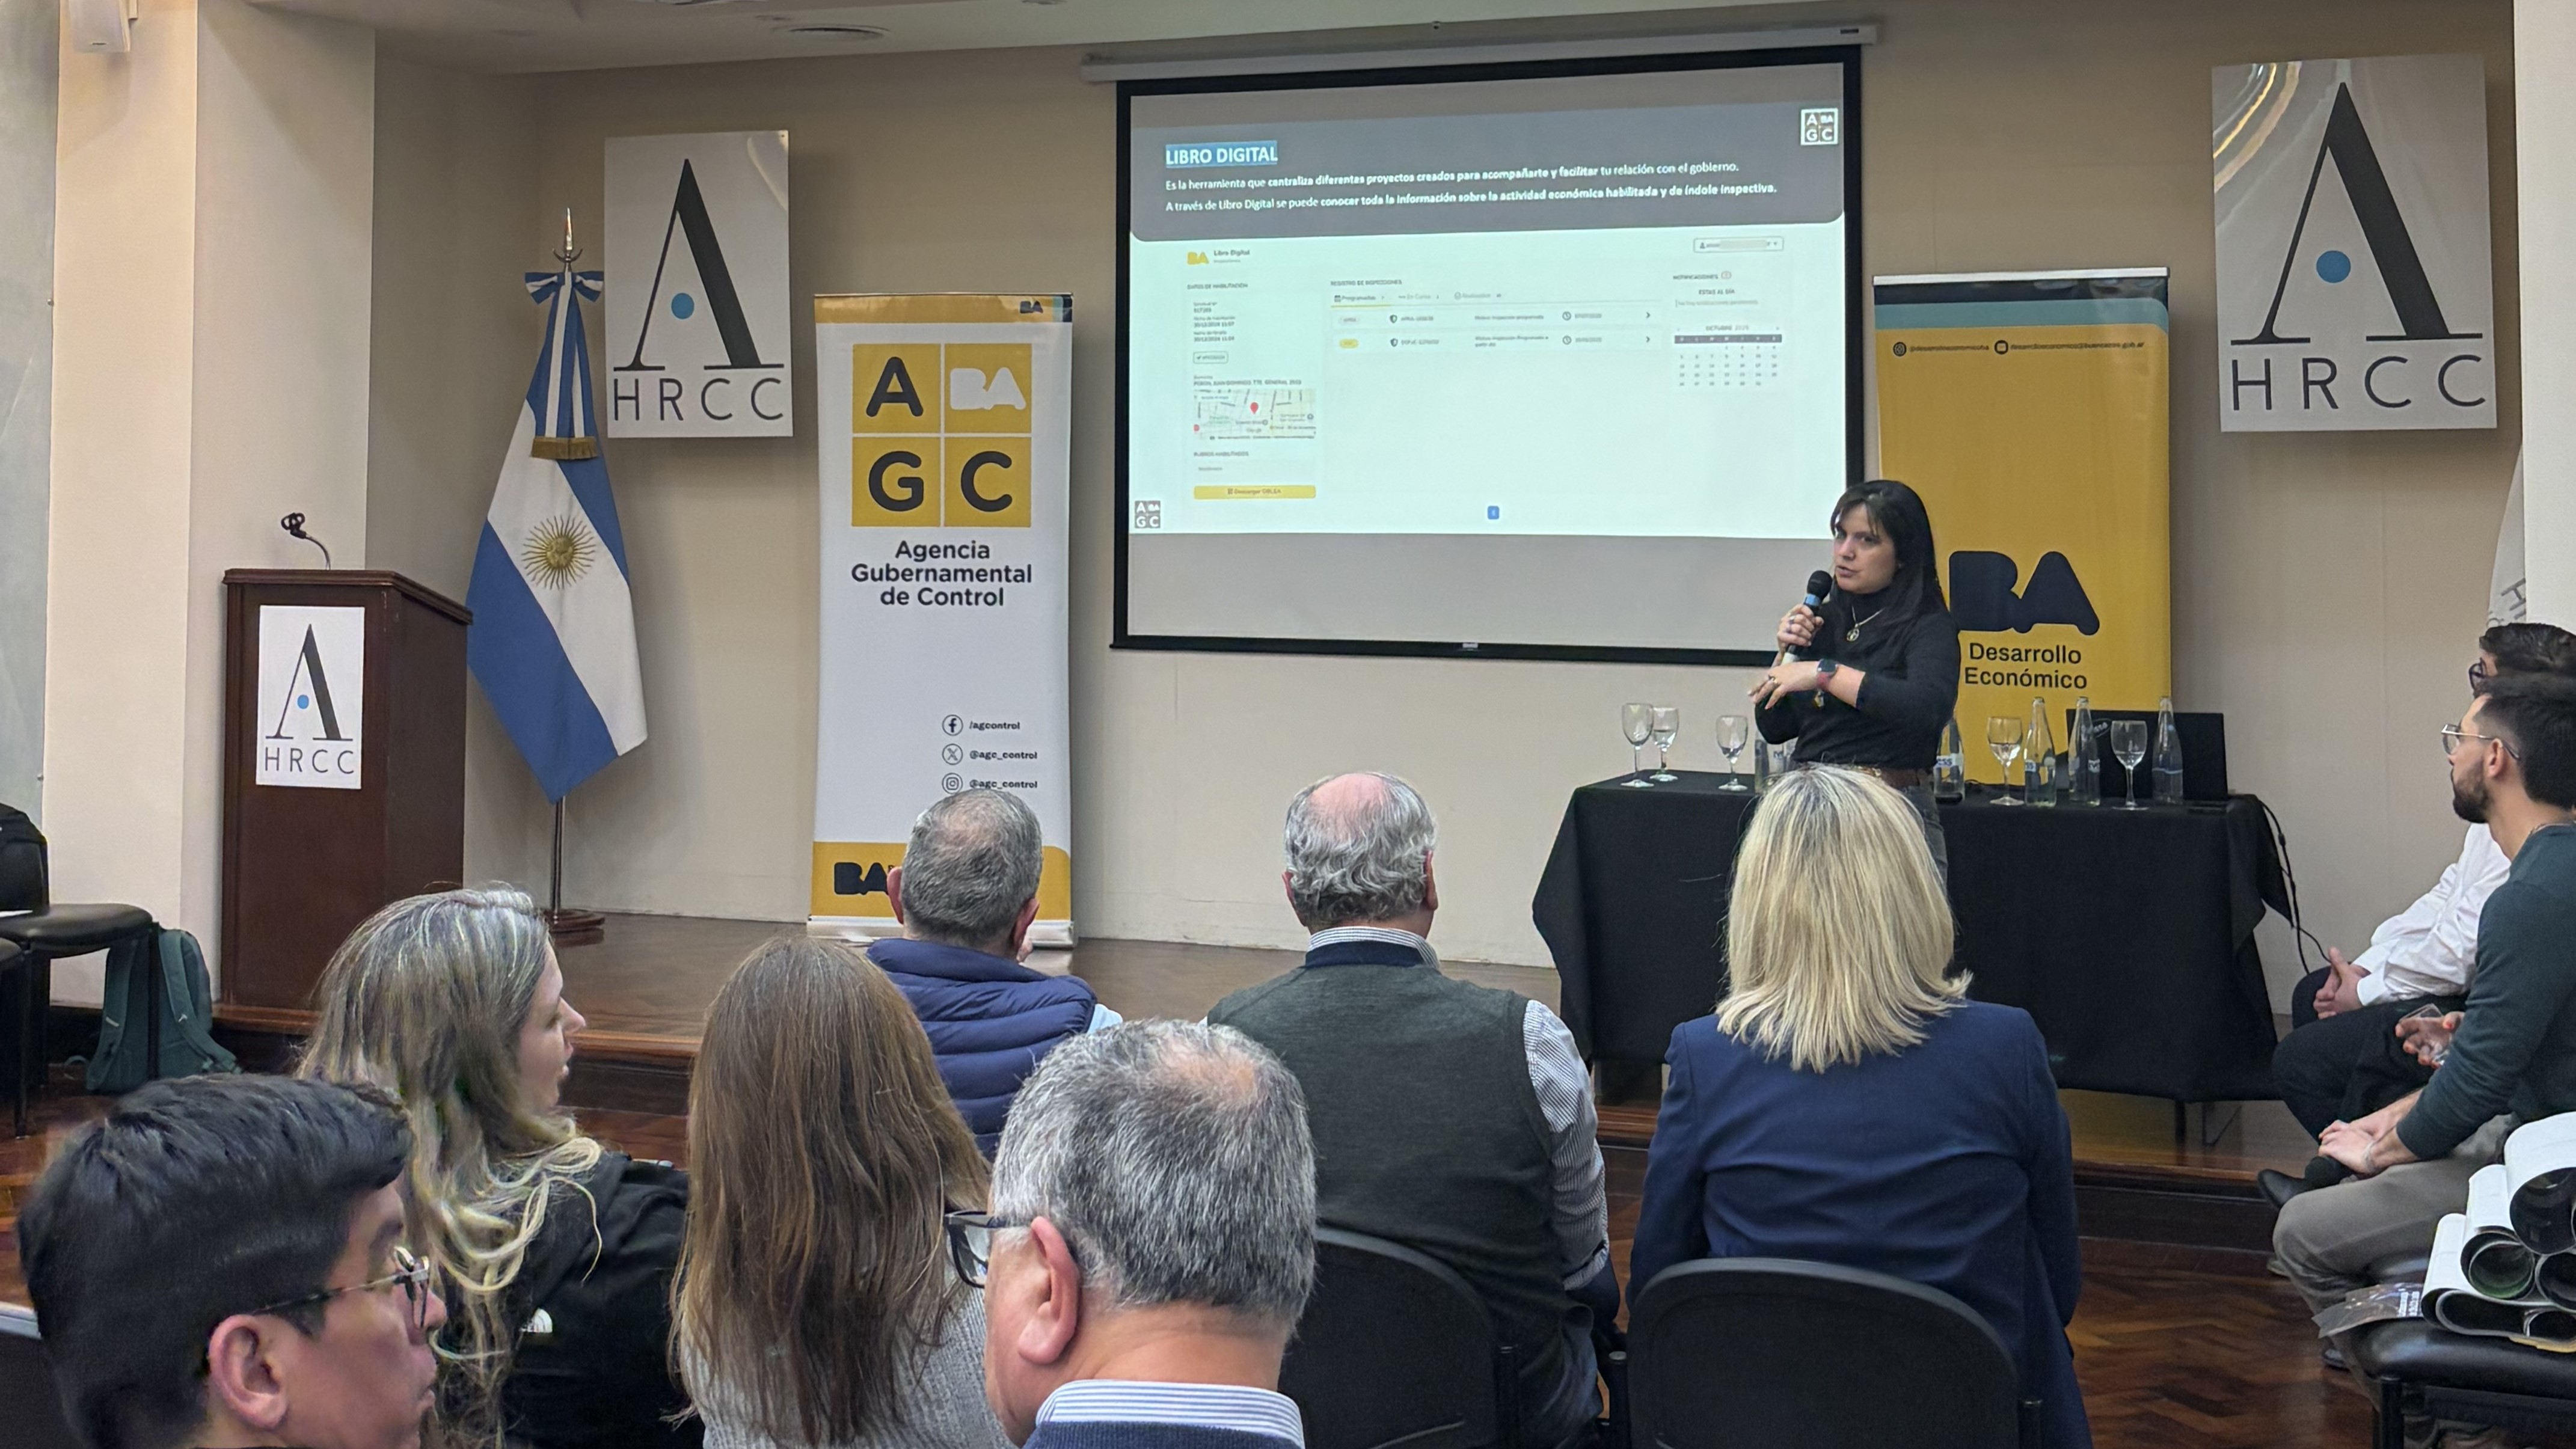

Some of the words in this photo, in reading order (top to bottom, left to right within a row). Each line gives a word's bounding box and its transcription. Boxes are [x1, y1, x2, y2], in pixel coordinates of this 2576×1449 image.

[1166, 149, 1212, 165] LIBRO
[1216, 146, 1278, 164] DIGITAL
[1166, 180, 1177, 191] Es
[1179, 180, 1186, 190] la
[1189, 178, 1245, 190] herramienta
[1248, 180, 1266, 192] que
[1268, 176, 1313, 187] centraliza
[1315, 174, 1364, 185] diferentes
[1367, 173, 1414, 186] proyectos
[1417, 171, 1455, 182] creados
[1457, 172, 1480, 183] para
[1482, 167, 1548, 180] acompañarte
[1550, 169, 1557, 180] y
[1559, 166, 1598, 178] facilitar
[1601, 167, 1612, 176] tu
[1614, 164, 1654, 176] relación
[1657, 165, 1676, 174] con
[1678, 162, 1688, 174] el
[1690, 161, 1739, 175] gobierno.
[1166, 202, 1173, 212] A
[1175, 200, 1203, 212] través
[1205, 200, 1216, 210] de
[1219, 200, 1242, 210] Libro
[1245, 198, 1274, 211] Digital
[1277, 200, 1287, 209] se
[1289, 197, 1319, 209] puede
[1320, 197, 1359, 207] conocer
[1361, 194, 1384, 206] toda
[1385, 194, 1394, 204] la
[1397, 192, 1456, 204] información
[1459, 191, 1486, 202] sobre
[1488, 191, 1498, 201] la
[1500, 189, 1546, 201] actividad
[1548, 187, 1604, 200] económica
[1606, 185, 1658, 198] habilitada
[1660, 188, 1667, 198] y
[1669, 185, 1682, 196] de
[1685, 184, 1718, 195] índole
[866, 357, 924, 417] A
[2232, 354, 2486, 410] HRCC
[614, 378, 784, 420] HRCC
[869, 451, 924, 512] G
[960, 451, 1013, 512] C
[895, 541, 990, 562] Agencia
[851, 563, 1032, 583] Gubernamental
[880, 587, 909, 605] de
[917, 587, 1004, 606] Control
[1969, 643, 2082, 664] Desarrollo
[1964, 667, 2087, 689] Económico
[969, 720, 1020, 731] /agcontrol
[265, 747, 354, 774] HRCC
[969, 750, 1037, 761] @agc_control
[969, 779, 1037, 789] @agc_control
